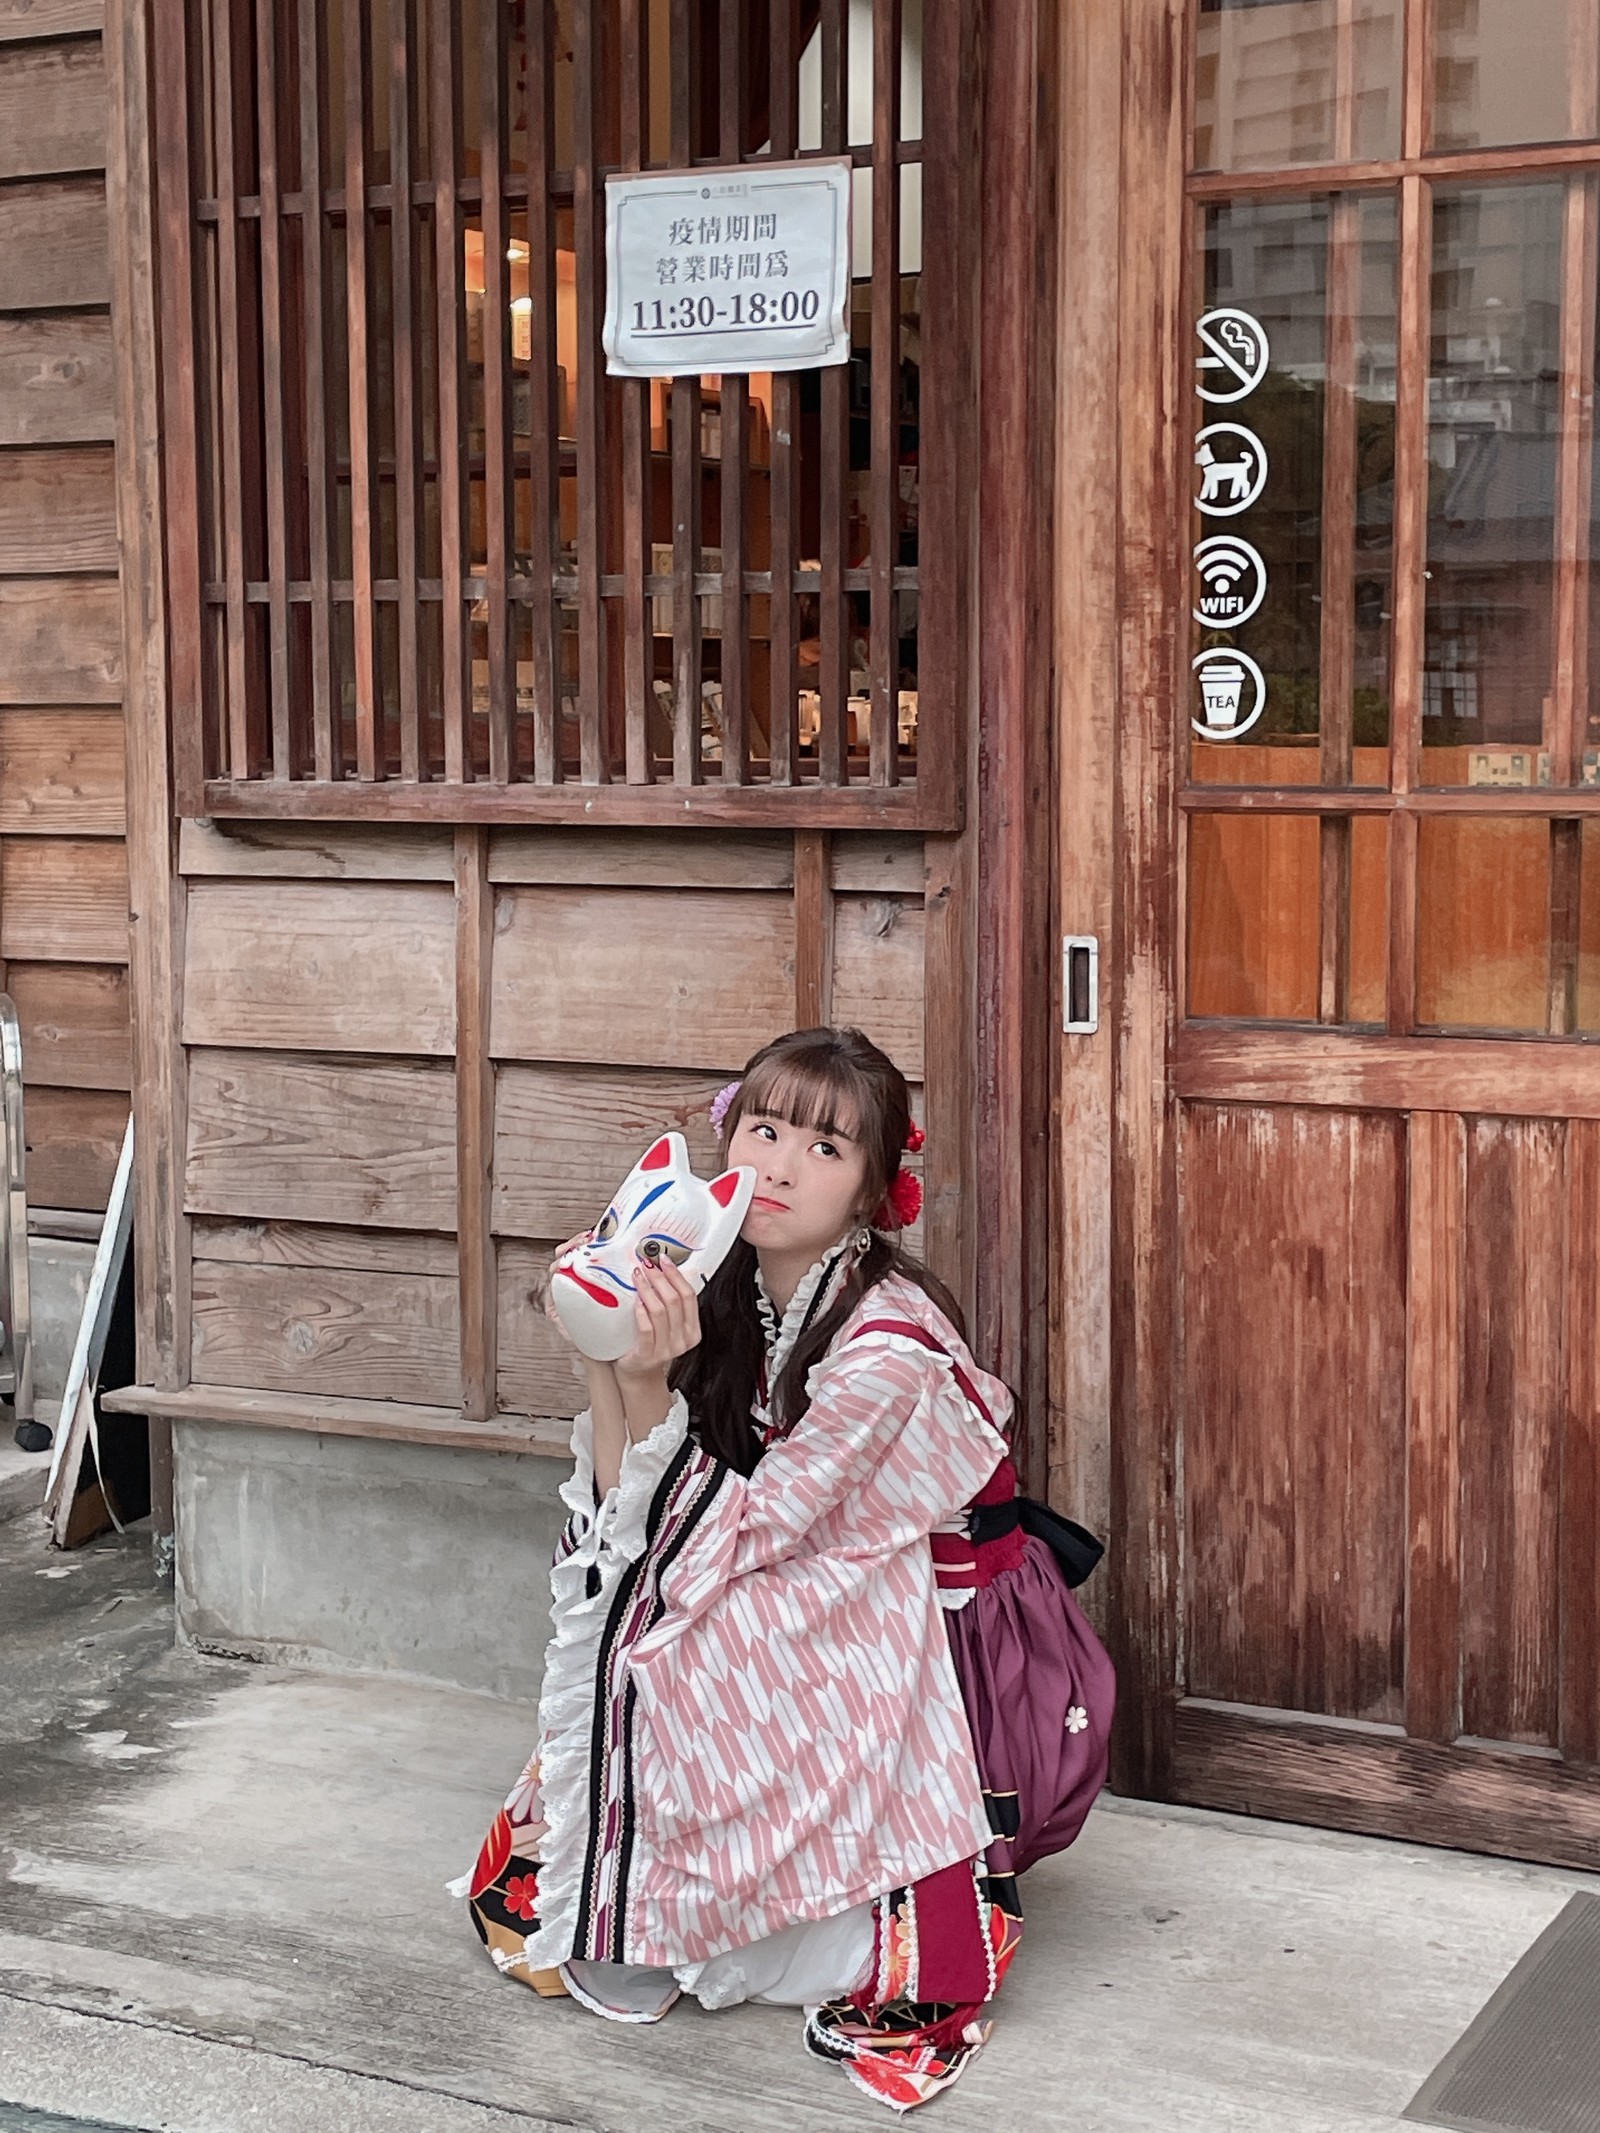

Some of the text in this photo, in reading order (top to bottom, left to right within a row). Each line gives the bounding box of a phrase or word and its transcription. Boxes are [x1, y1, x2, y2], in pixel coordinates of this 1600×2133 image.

[668, 213, 777, 246] 疫情期間
[631, 290, 819, 331] 11:30-18:00
[1200, 596, 1244, 614] WIFI
[1206, 695, 1235, 708] TEA
